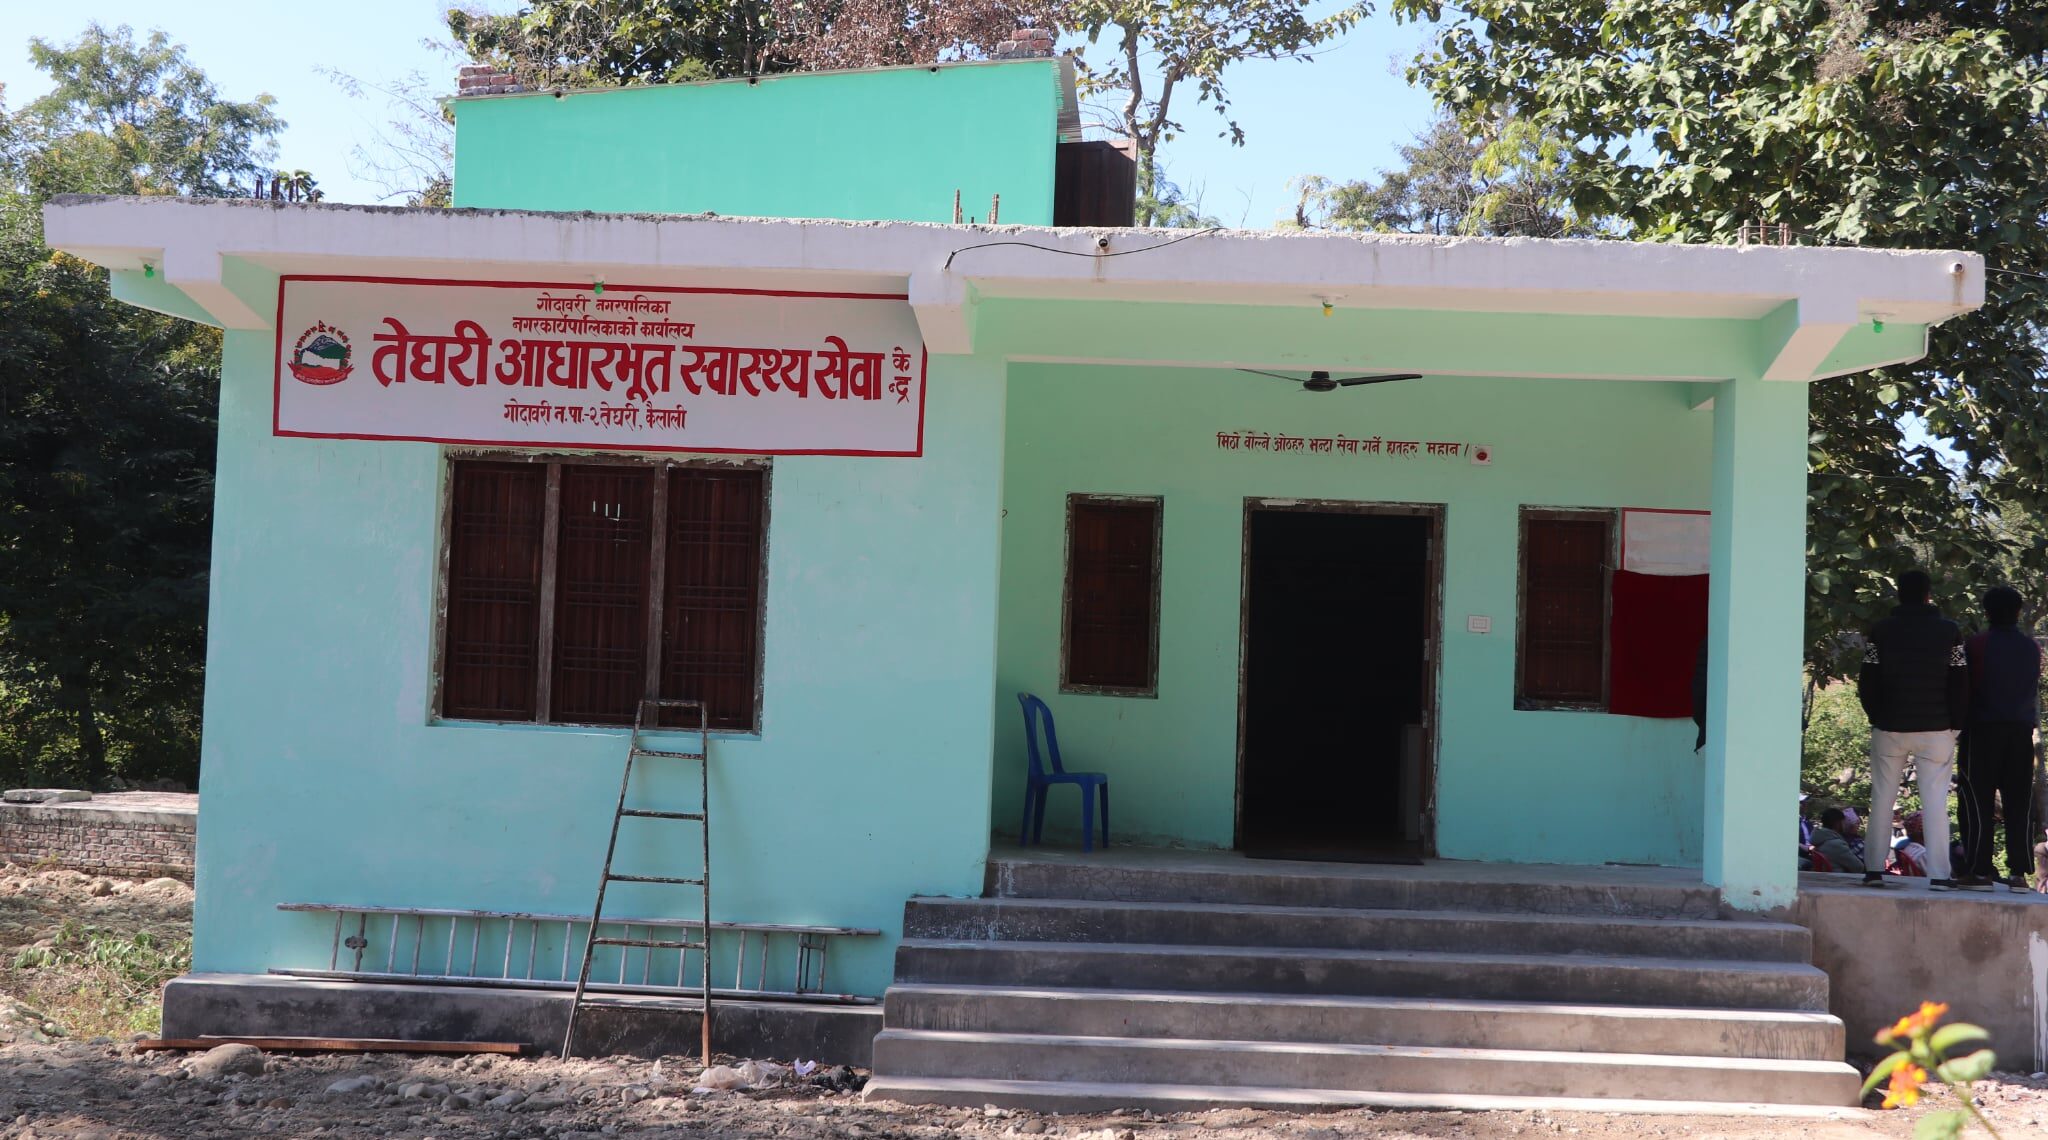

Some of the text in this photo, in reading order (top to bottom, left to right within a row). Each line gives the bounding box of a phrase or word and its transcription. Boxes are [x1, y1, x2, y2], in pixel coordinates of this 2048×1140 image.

[537, 292, 671, 315] गोदावरी नगरपालिका
[512, 315, 695, 339] नगरकार्यपालिकाको कार्यालय
[372, 317, 492, 387] तेघरी
[495, 339, 675, 402] आधारभूत
[680, 345, 812, 397] स्वास्थ्य
[814, 335, 885, 400] सेवा
[504, 398, 552, 426] गोदावरी
[645, 401, 687, 430] कैलाली
[1216, 431, 1241, 450] मिठो
[1308, 437, 1333, 454] भन्दा
[1336, 434, 1359, 456] सेवा
